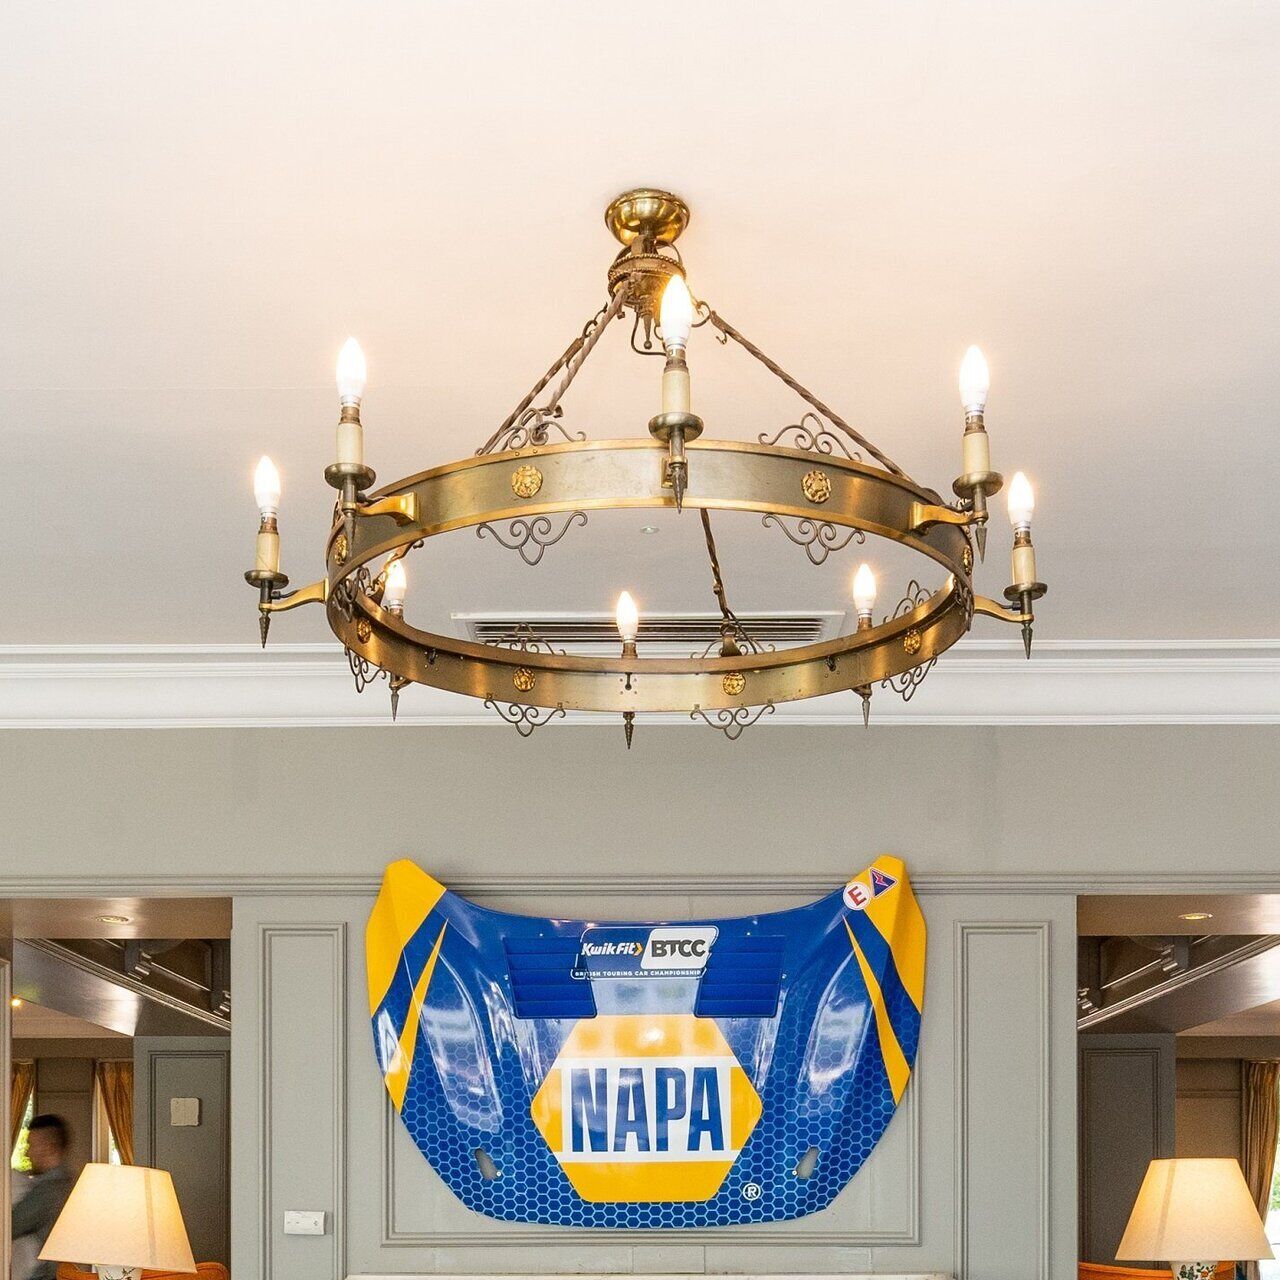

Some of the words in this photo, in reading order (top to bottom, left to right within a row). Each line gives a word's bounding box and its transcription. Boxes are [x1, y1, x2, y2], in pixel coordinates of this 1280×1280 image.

[847, 886, 867, 906] E
[651, 940, 706, 958] BTCC
[571, 1066, 725, 1152] NAPA
